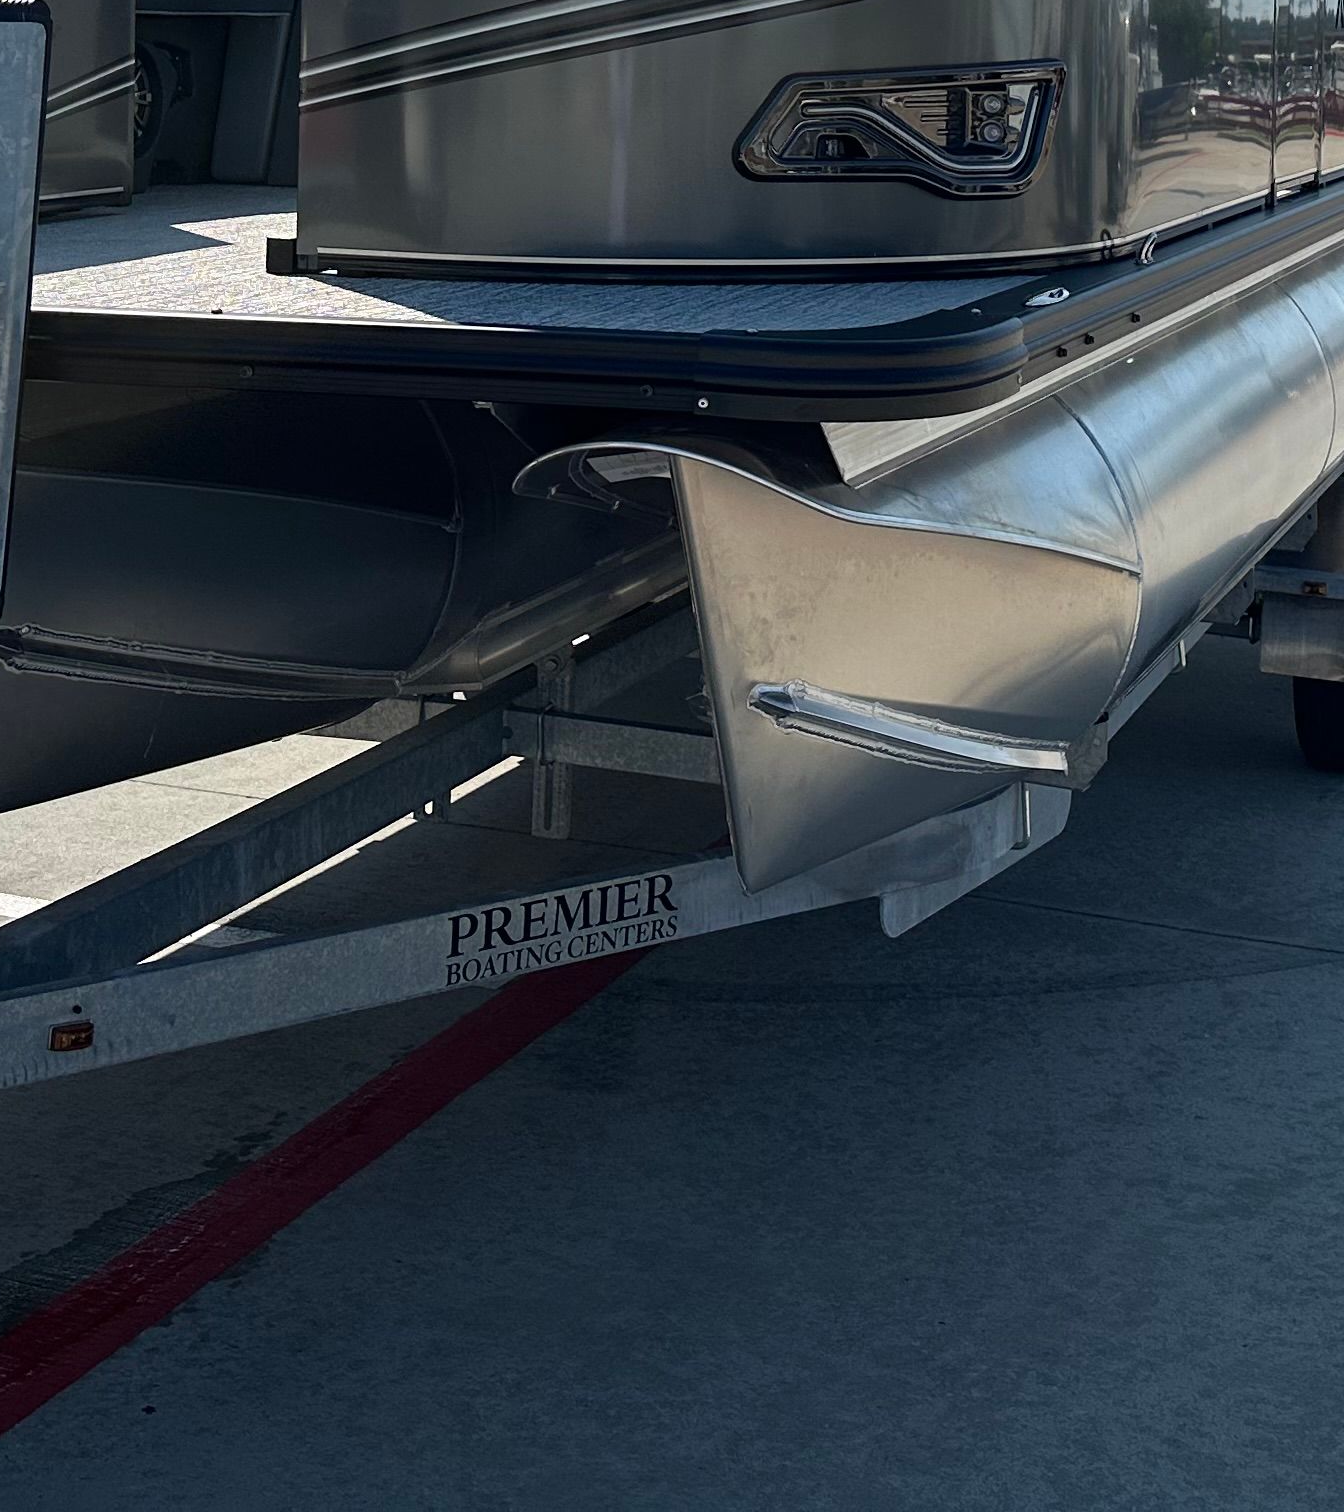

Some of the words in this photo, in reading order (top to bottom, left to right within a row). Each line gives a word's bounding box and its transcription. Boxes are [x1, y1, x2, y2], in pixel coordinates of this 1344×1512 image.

[445, 940, 562, 987] BOATING
[567, 916, 678, 958] CENTERS
[446, 874, 678, 959] PREMIER
